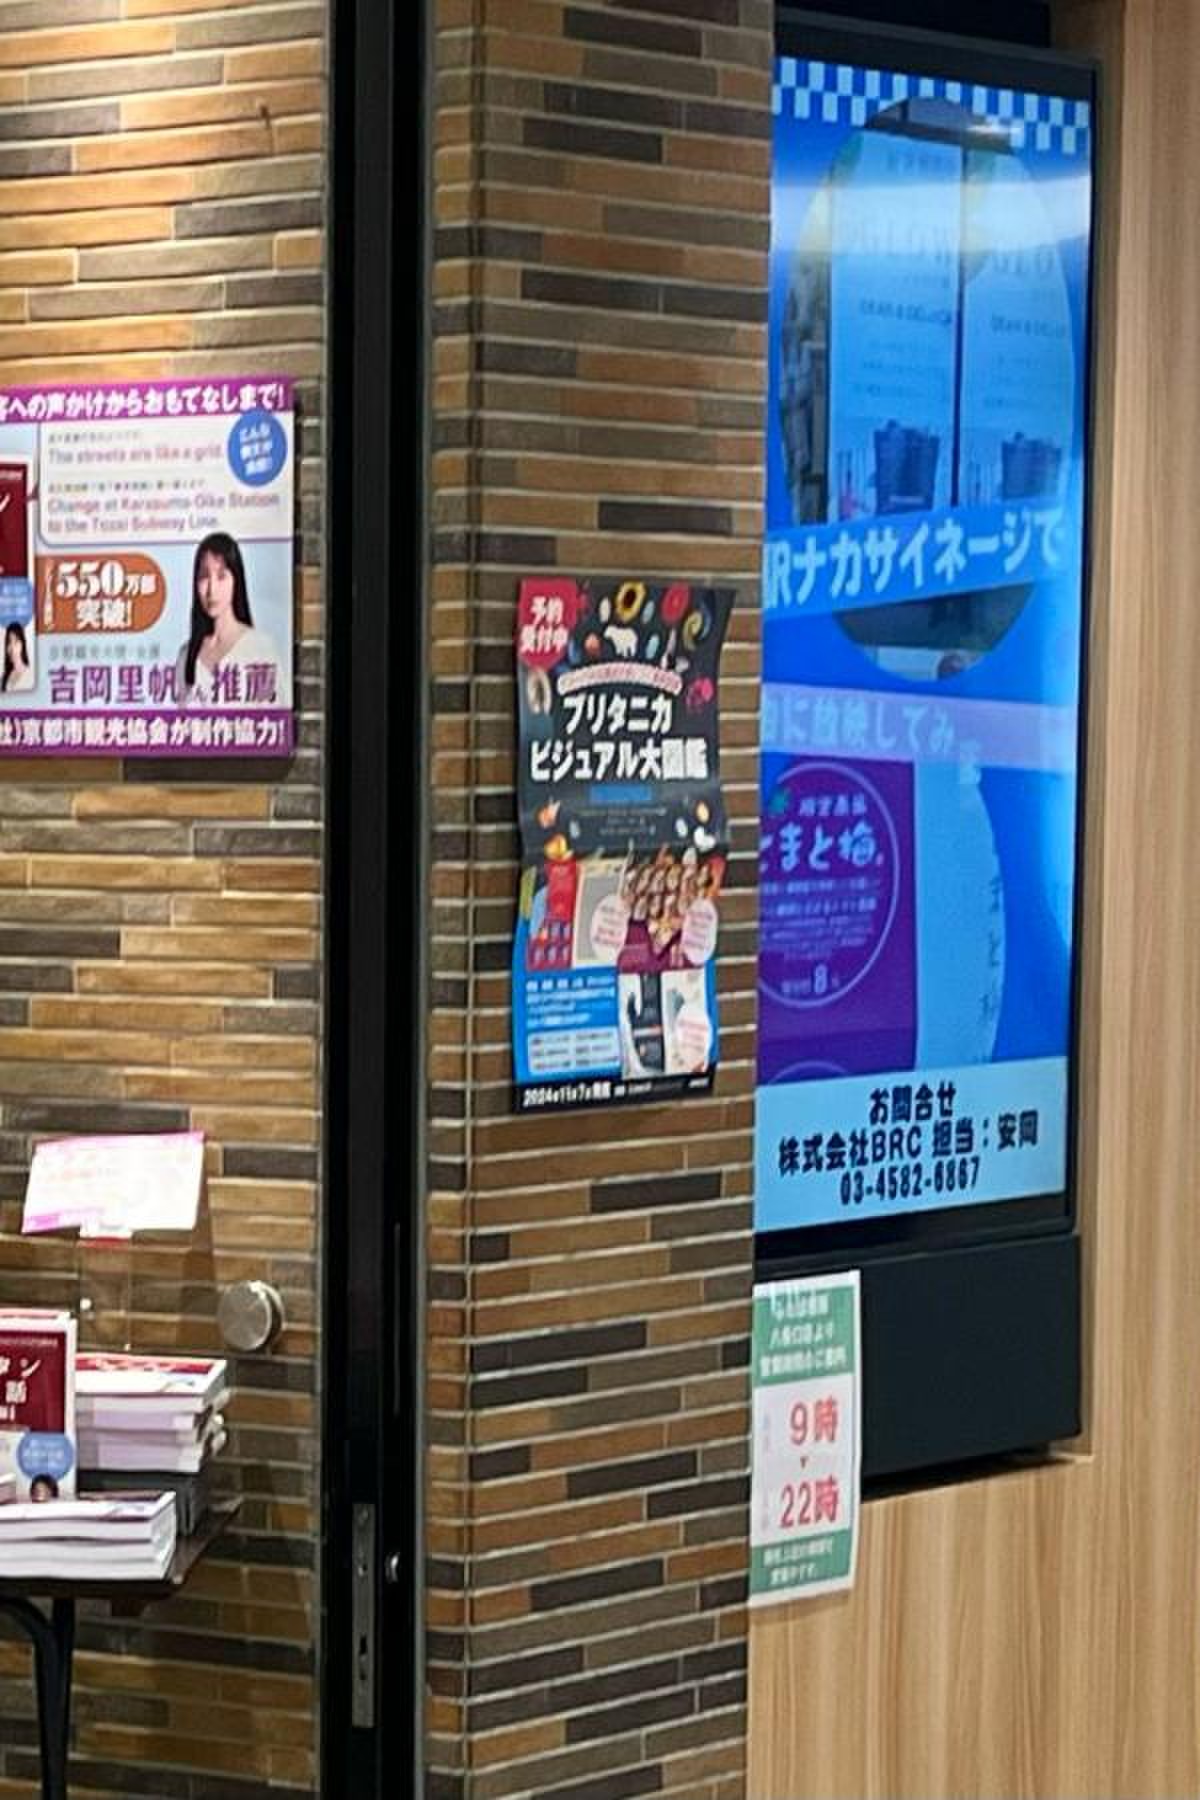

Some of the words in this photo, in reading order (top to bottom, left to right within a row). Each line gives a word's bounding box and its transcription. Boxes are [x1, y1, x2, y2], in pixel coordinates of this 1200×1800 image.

[77, 447, 126, 463] streets
[48, 497, 101, 514] Change
[65, 517, 88, 532] the
[531, 737, 708, 782] ビジュアル大図鑑
[870, 1081, 956, 1123] お問合せ
[778, 1127, 922, 1177] 株式会社BRC
[789, 1395, 838, 1446] 9時
[780, 1474, 839, 1530] 22時
